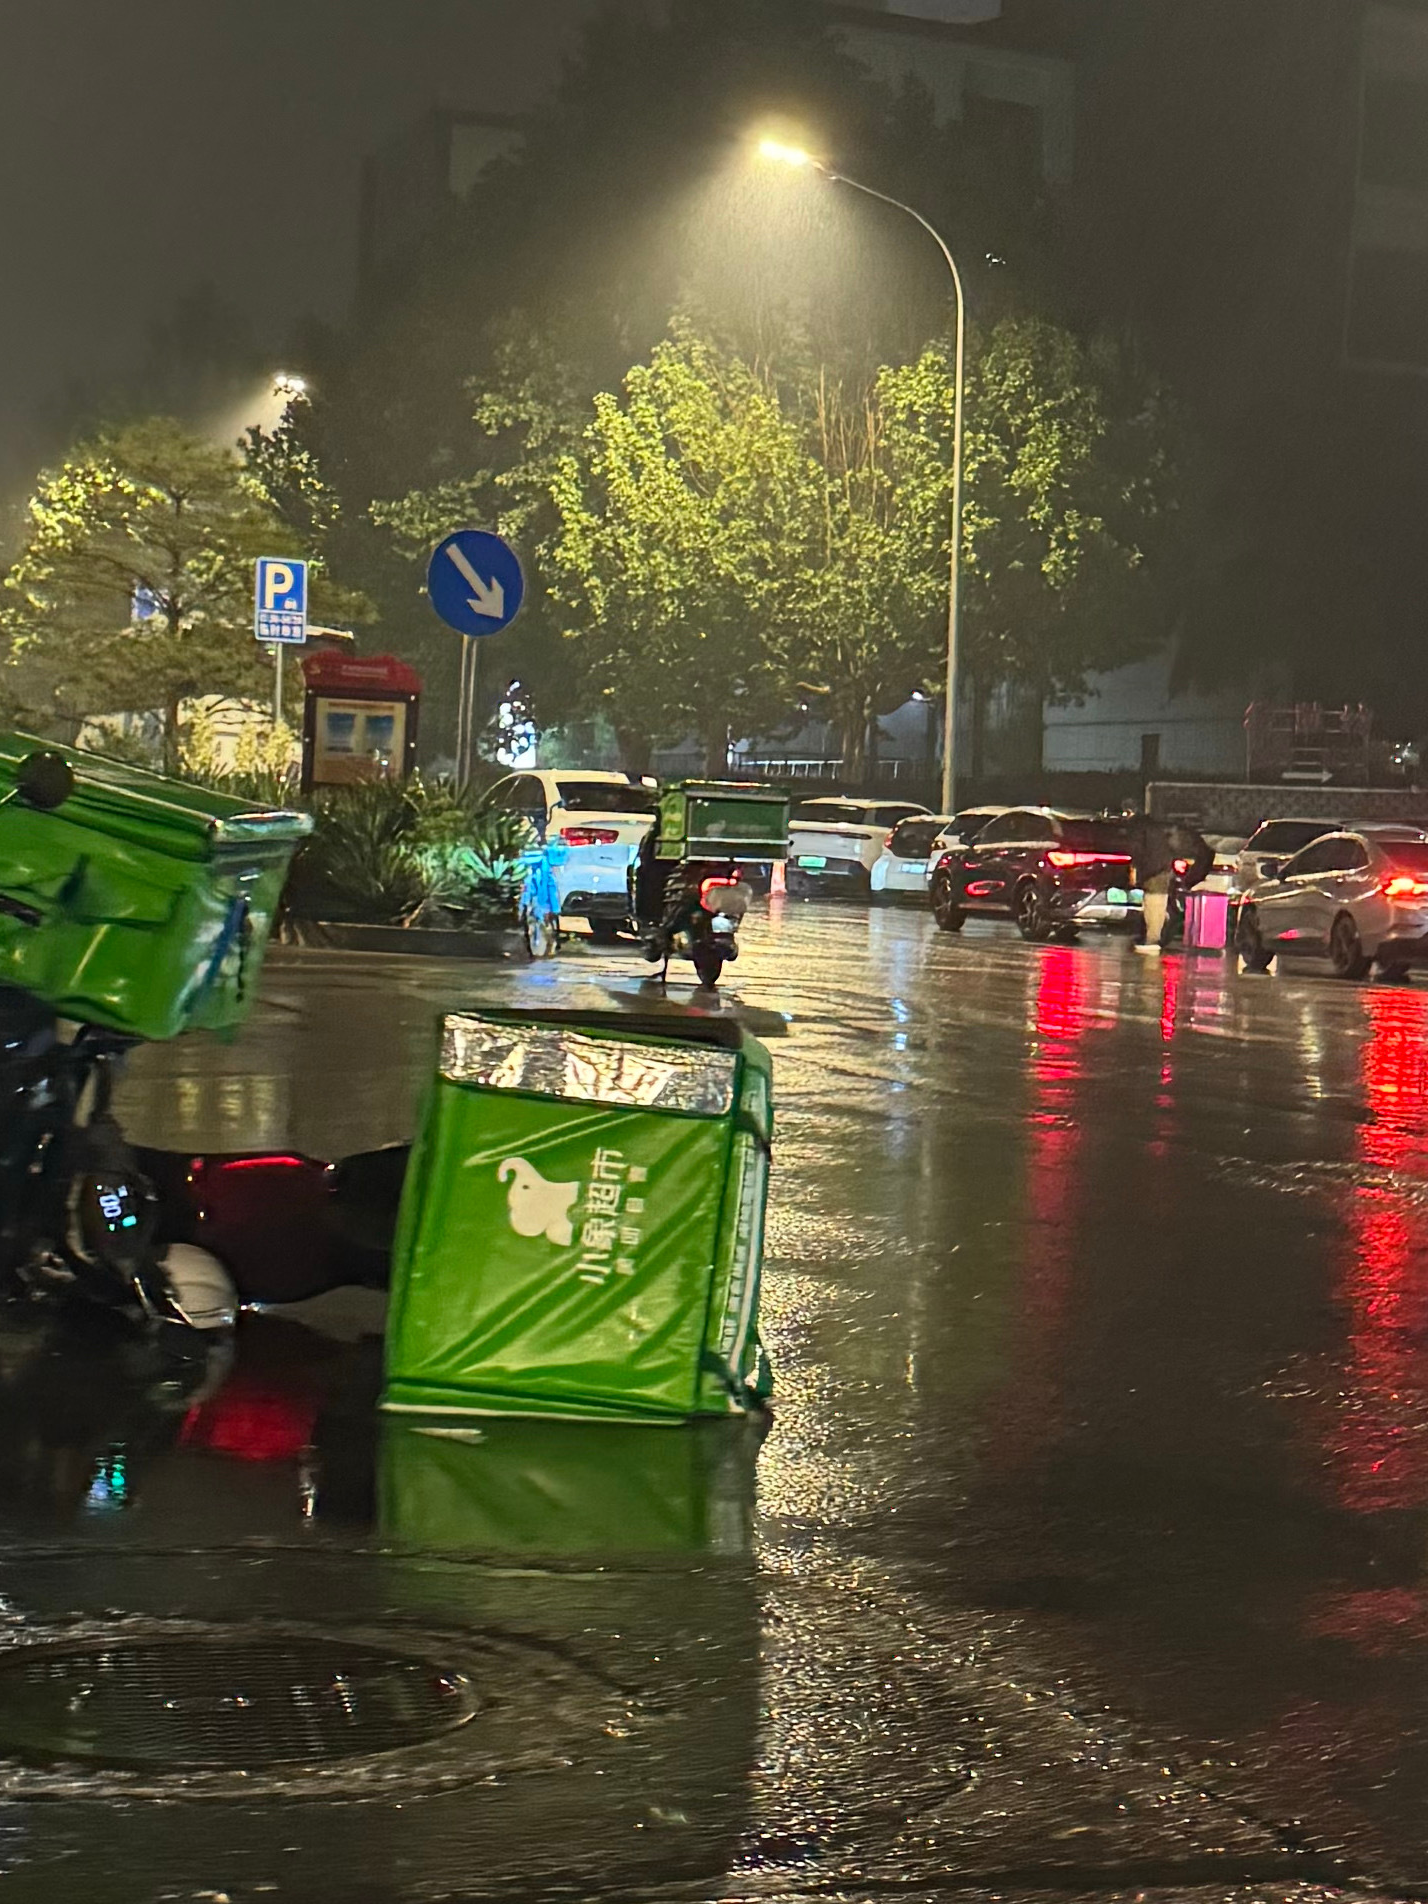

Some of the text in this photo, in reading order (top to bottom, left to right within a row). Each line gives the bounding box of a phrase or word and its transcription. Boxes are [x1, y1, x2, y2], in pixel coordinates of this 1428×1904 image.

[265, 562, 294, 609] P
[576, 1146, 628, 1284] 小象超市
